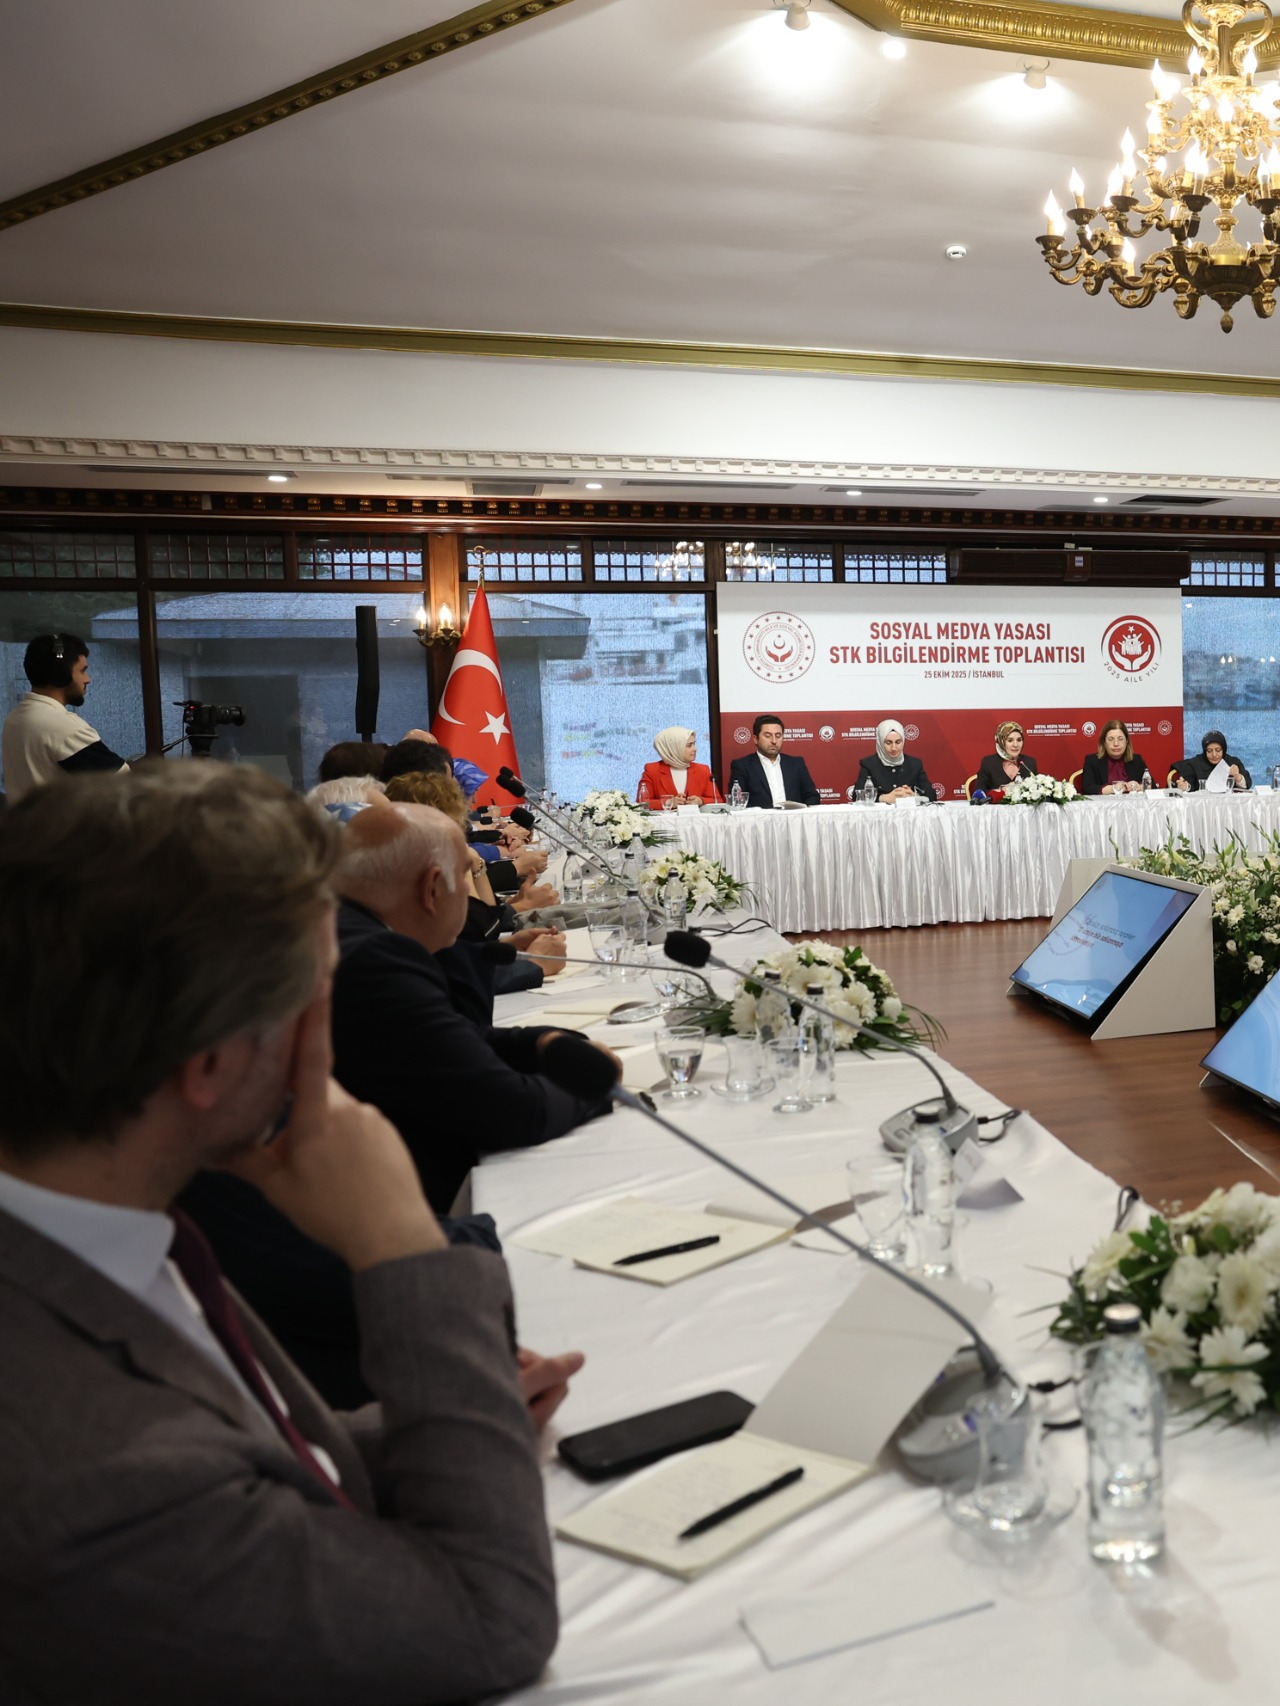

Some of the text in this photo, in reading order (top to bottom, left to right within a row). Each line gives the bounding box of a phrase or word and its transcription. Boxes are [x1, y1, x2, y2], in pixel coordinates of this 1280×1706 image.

[870, 622, 1051, 640] SOSYAL MEDYA YASASI
[830, 642, 1085, 663] STK BİLGİLENDİRME TOPLANTISI
[934, 670, 950, 678] EKİM
[972, 669, 1004, 678] İSTANBUL
[1104, 661, 1120, 679] 2025
[1146, 662, 1159, 677] YILI
